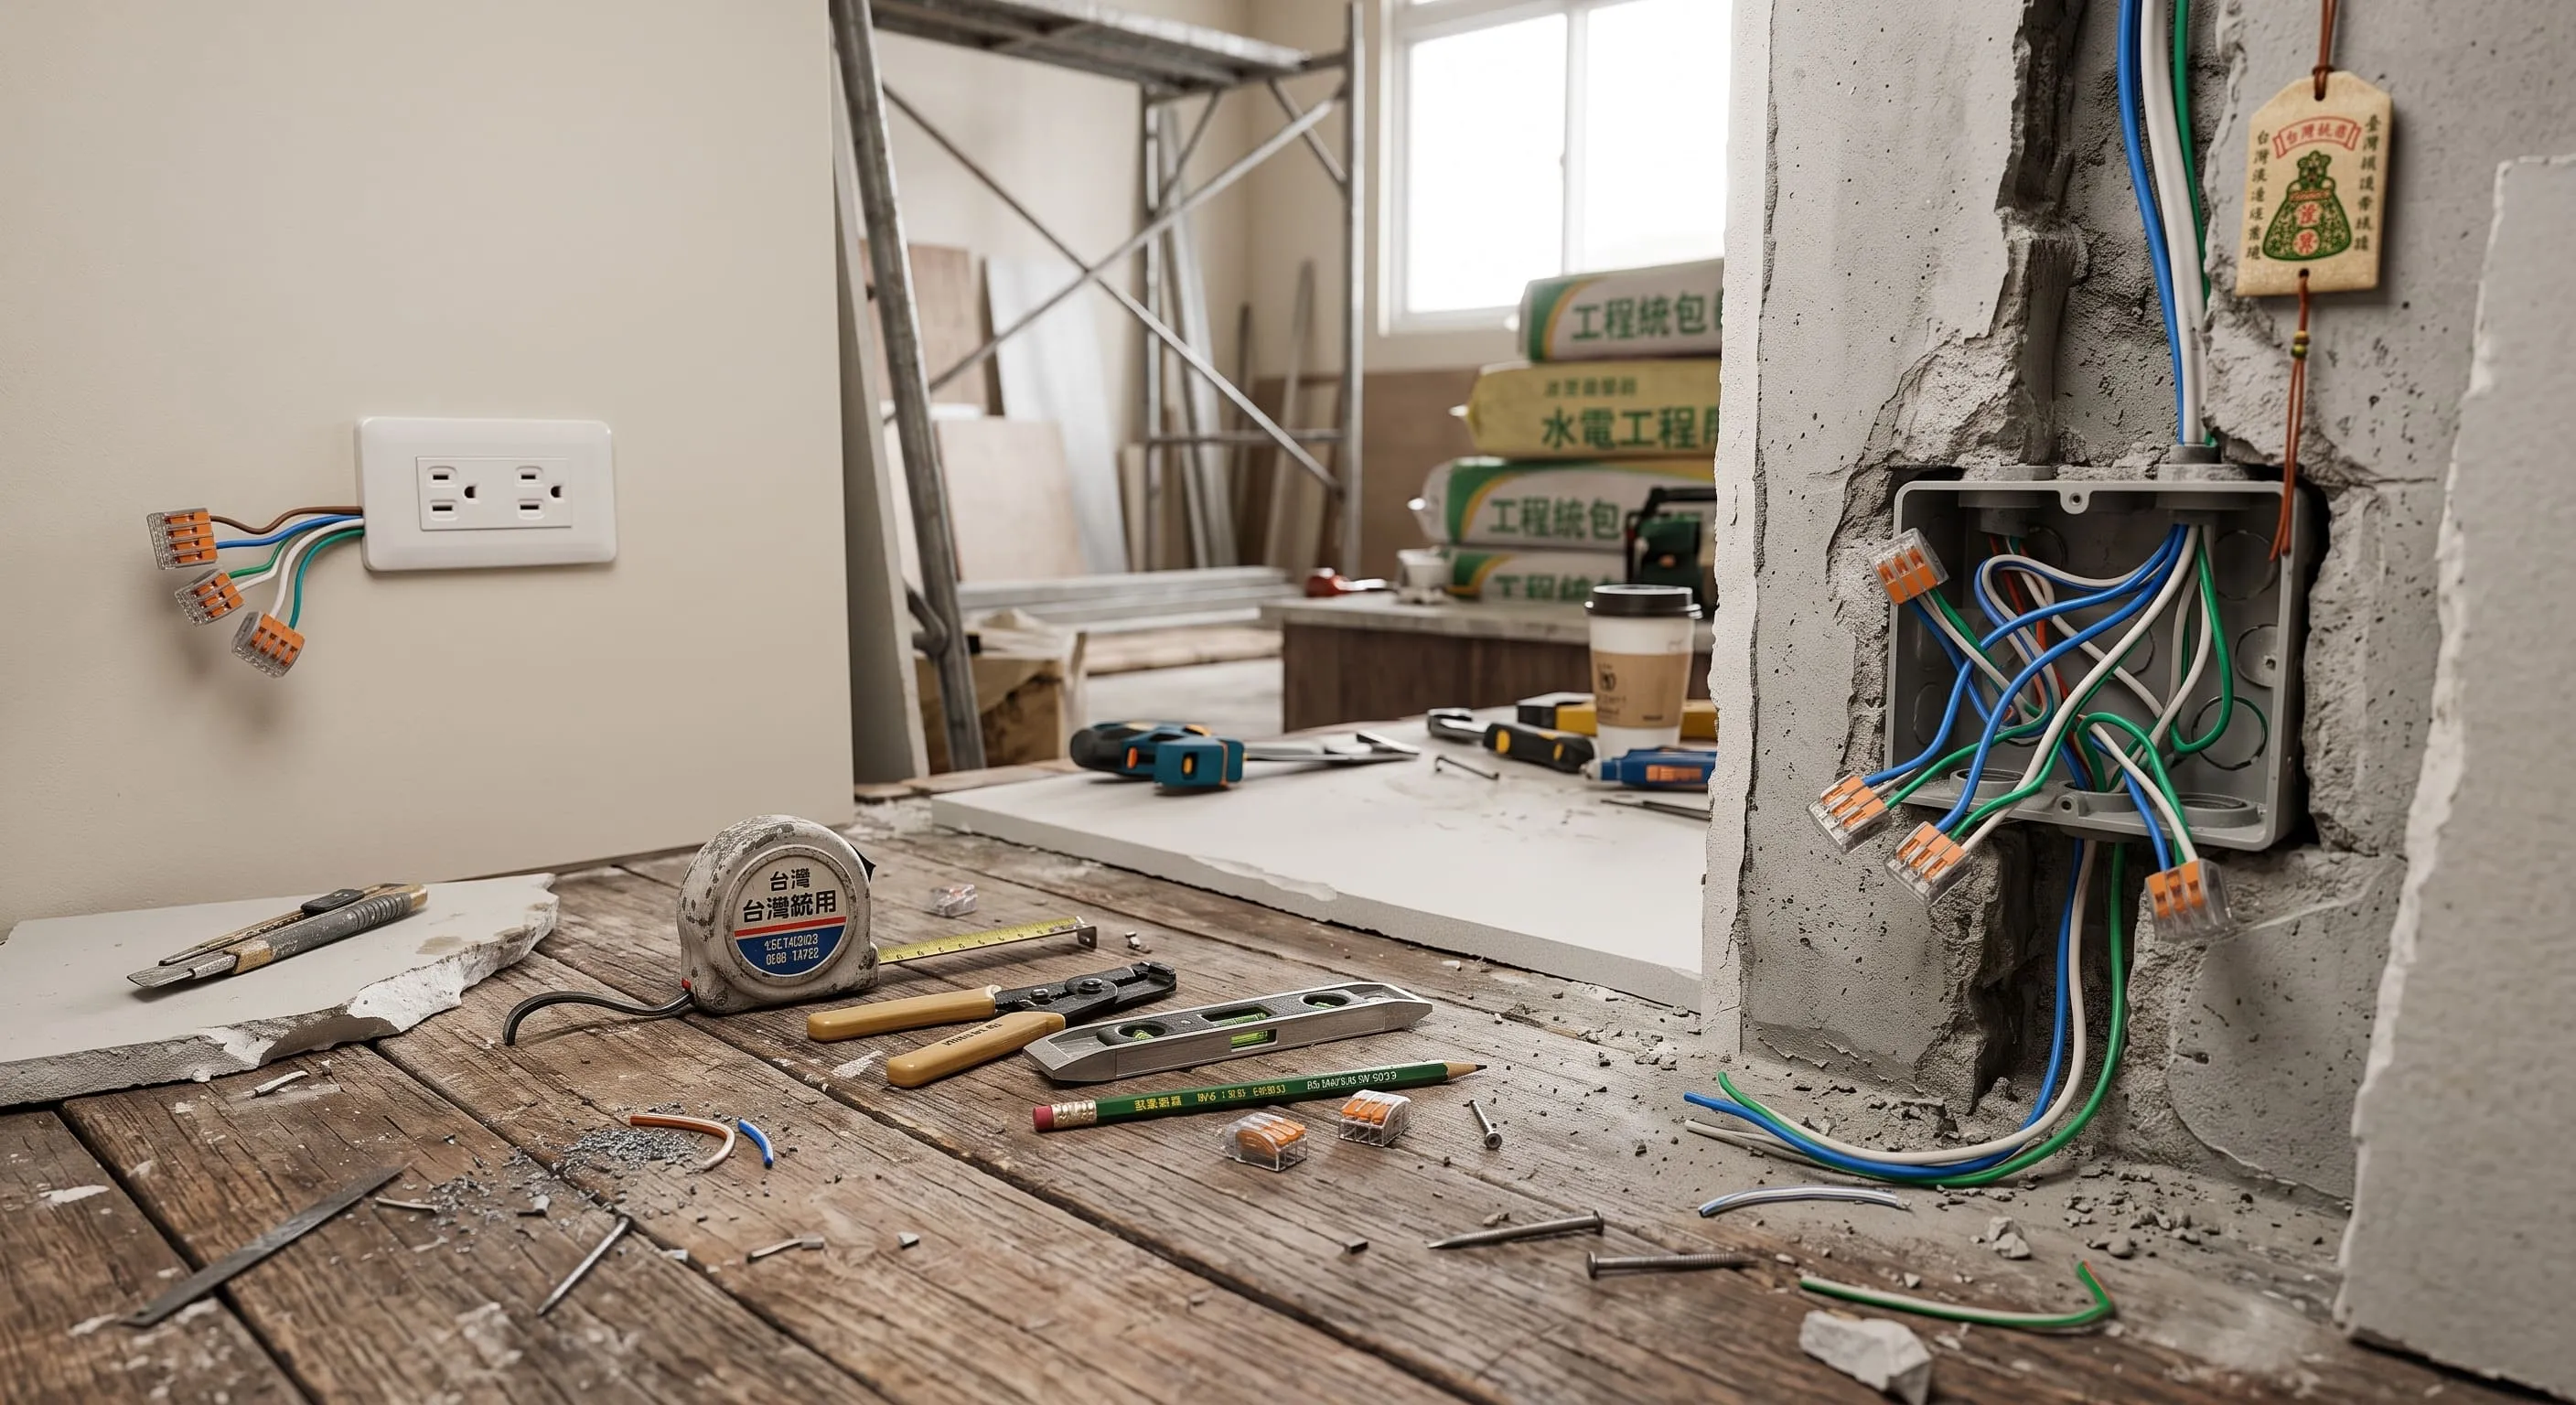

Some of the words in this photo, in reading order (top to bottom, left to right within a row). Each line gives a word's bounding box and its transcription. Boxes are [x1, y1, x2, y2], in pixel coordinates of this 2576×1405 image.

[1572, 290, 1723, 340] 工程統包
[770, 868, 810, 891] 台灣
[743, 890, 836, 922] 台灣統用
